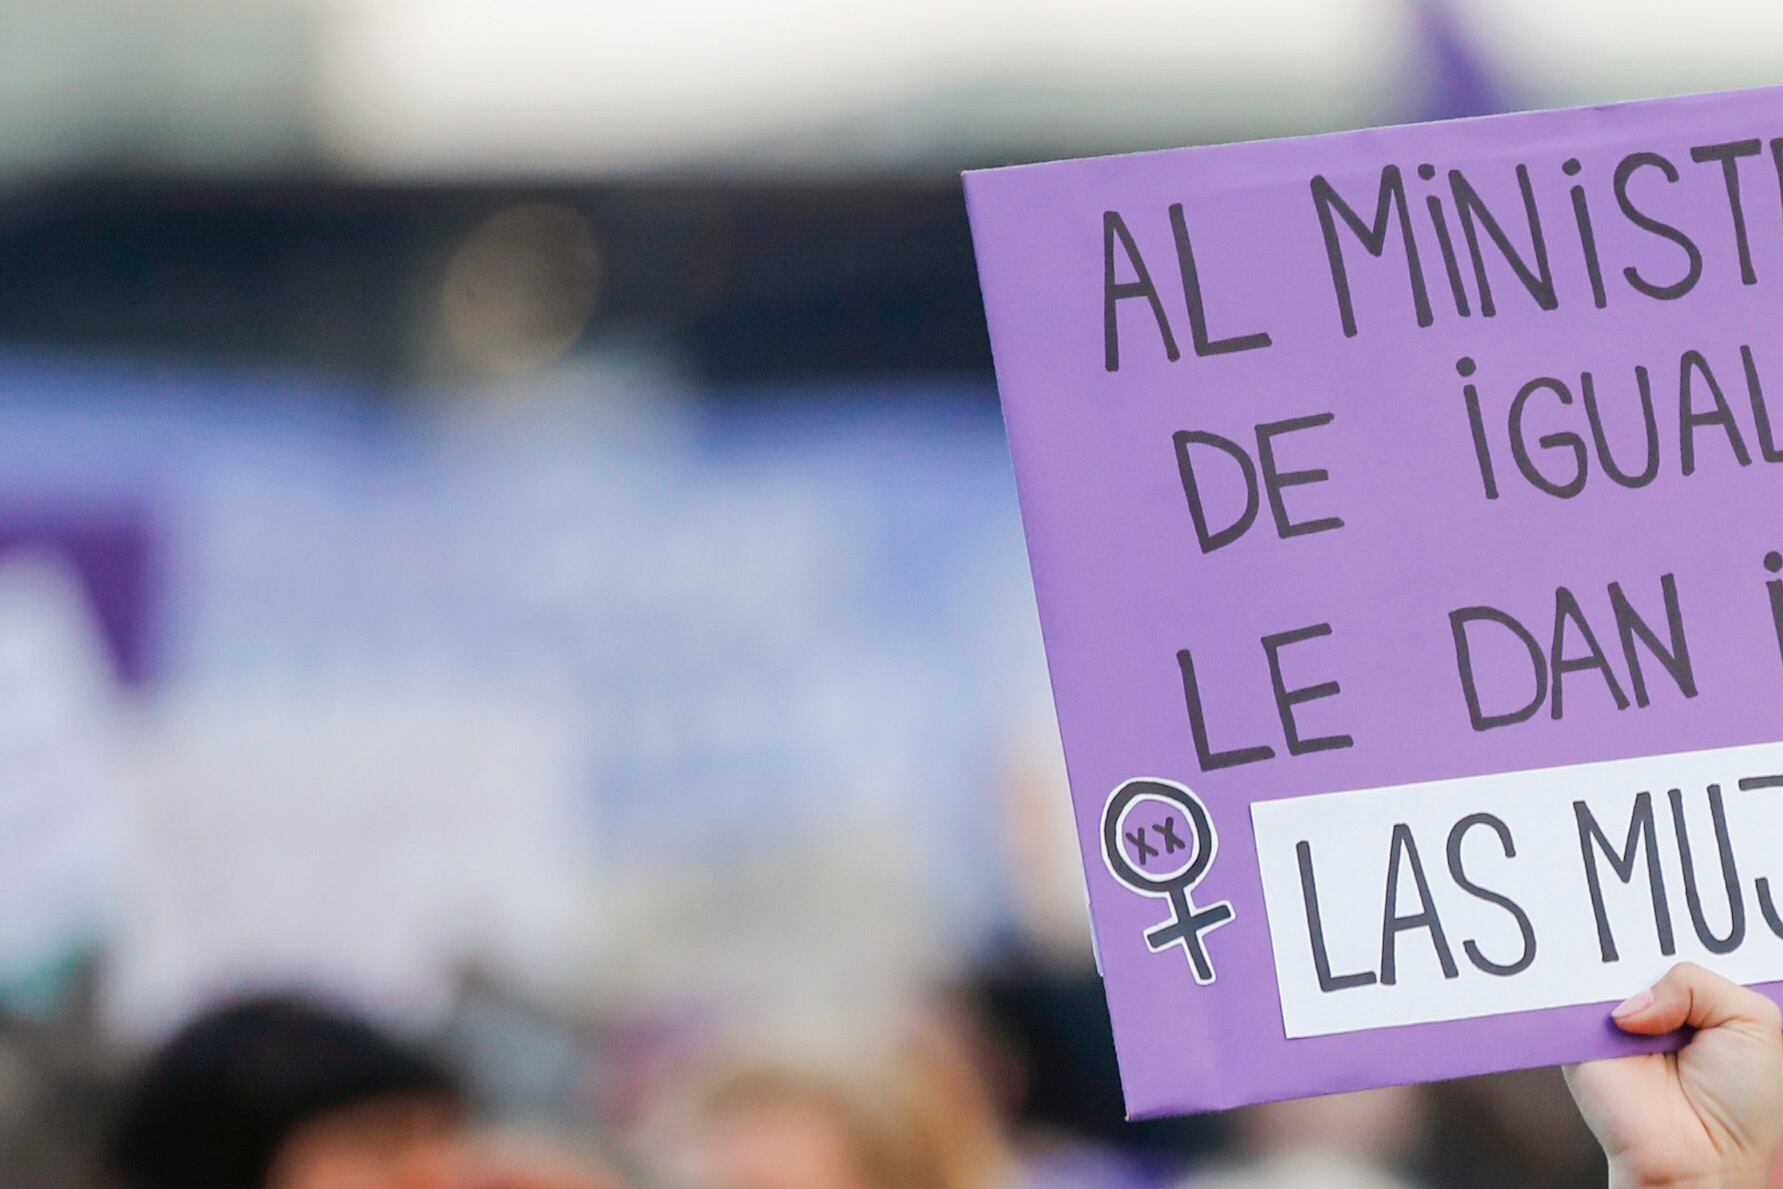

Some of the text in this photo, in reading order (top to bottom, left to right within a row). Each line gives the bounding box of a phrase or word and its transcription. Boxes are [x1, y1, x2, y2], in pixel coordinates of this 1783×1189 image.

[1103, 203, 1273, 372] AL
[1172, 412, 1345, 554] DE
[1176, 622, 1354, 772] LE
[1448, 573, 1698, 732] DAN
[1295, 812, 1537, 993] LAS
